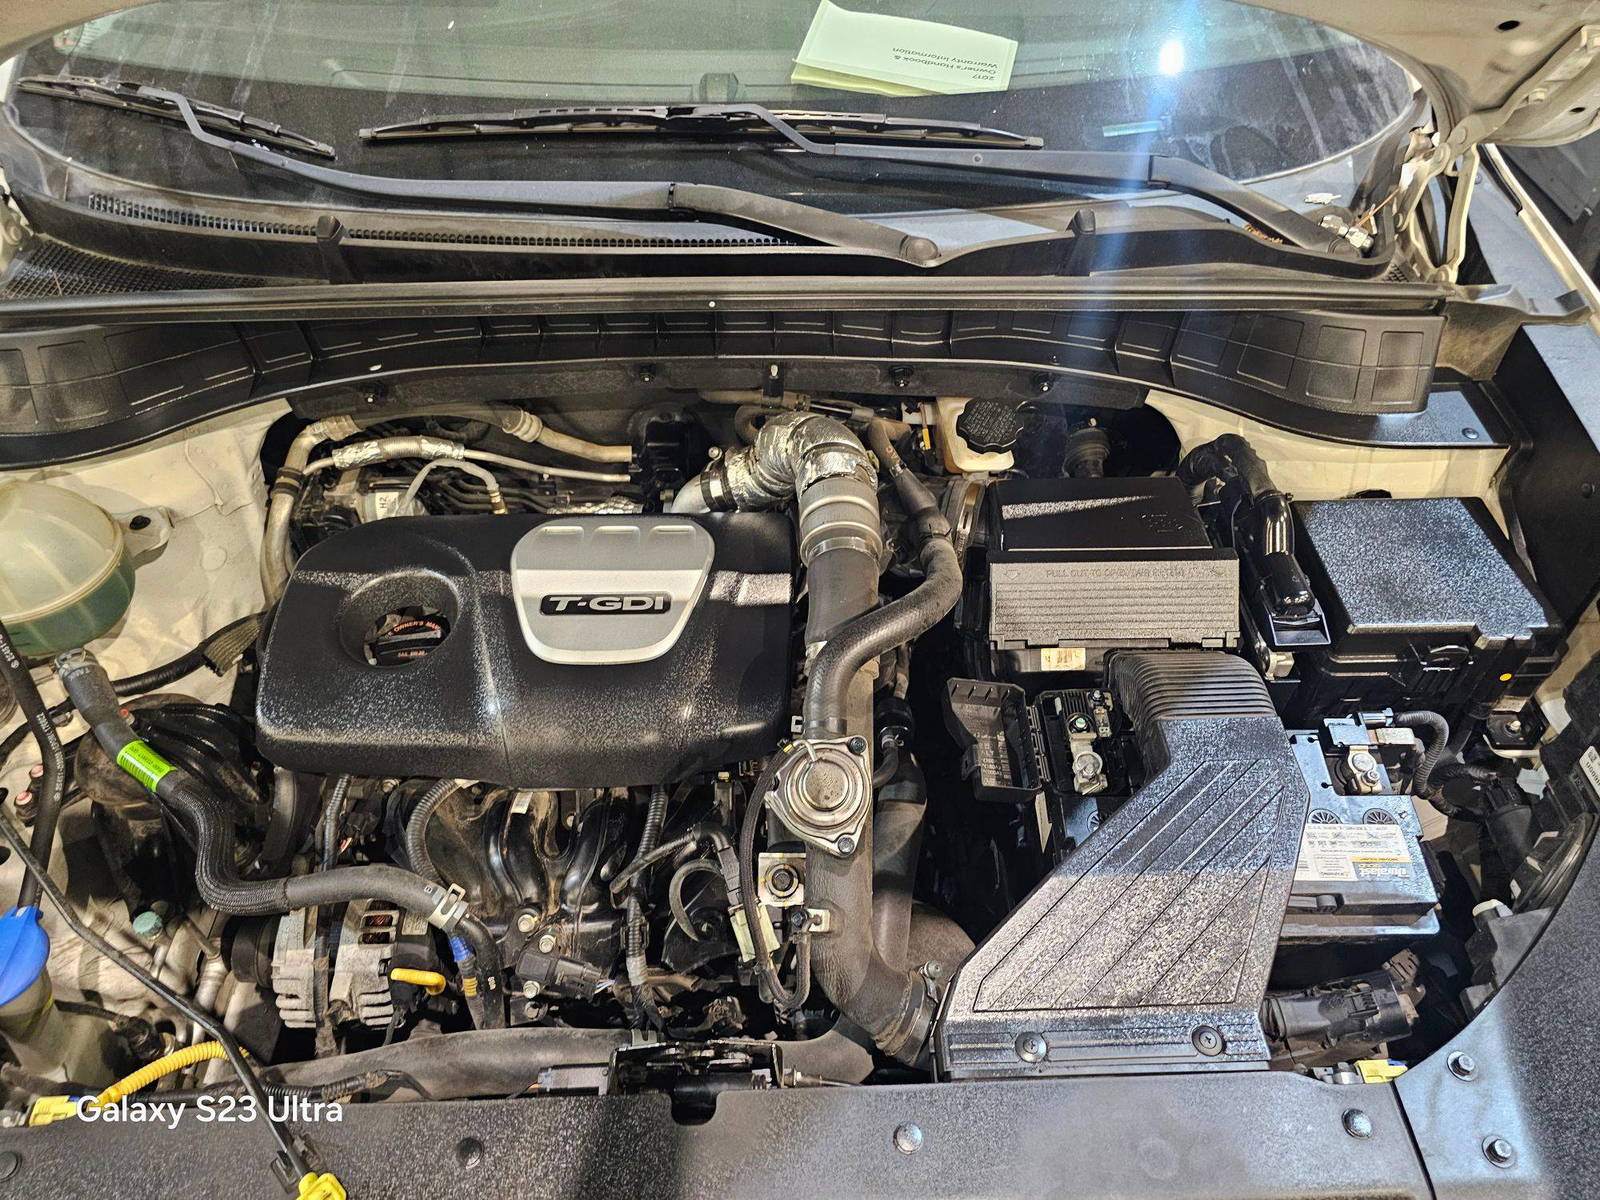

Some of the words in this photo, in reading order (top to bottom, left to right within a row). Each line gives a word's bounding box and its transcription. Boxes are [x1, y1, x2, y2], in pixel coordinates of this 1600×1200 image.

[892, 47, 949, 62] Information
[903, 56, 954, 70] Handbook
[951, 57, 998, 69] Warranty
[955, 65, 997, 75] Owner's
[972, 73, 996, 81] 2017
[394, 620, 424, 633] OWNER'S
